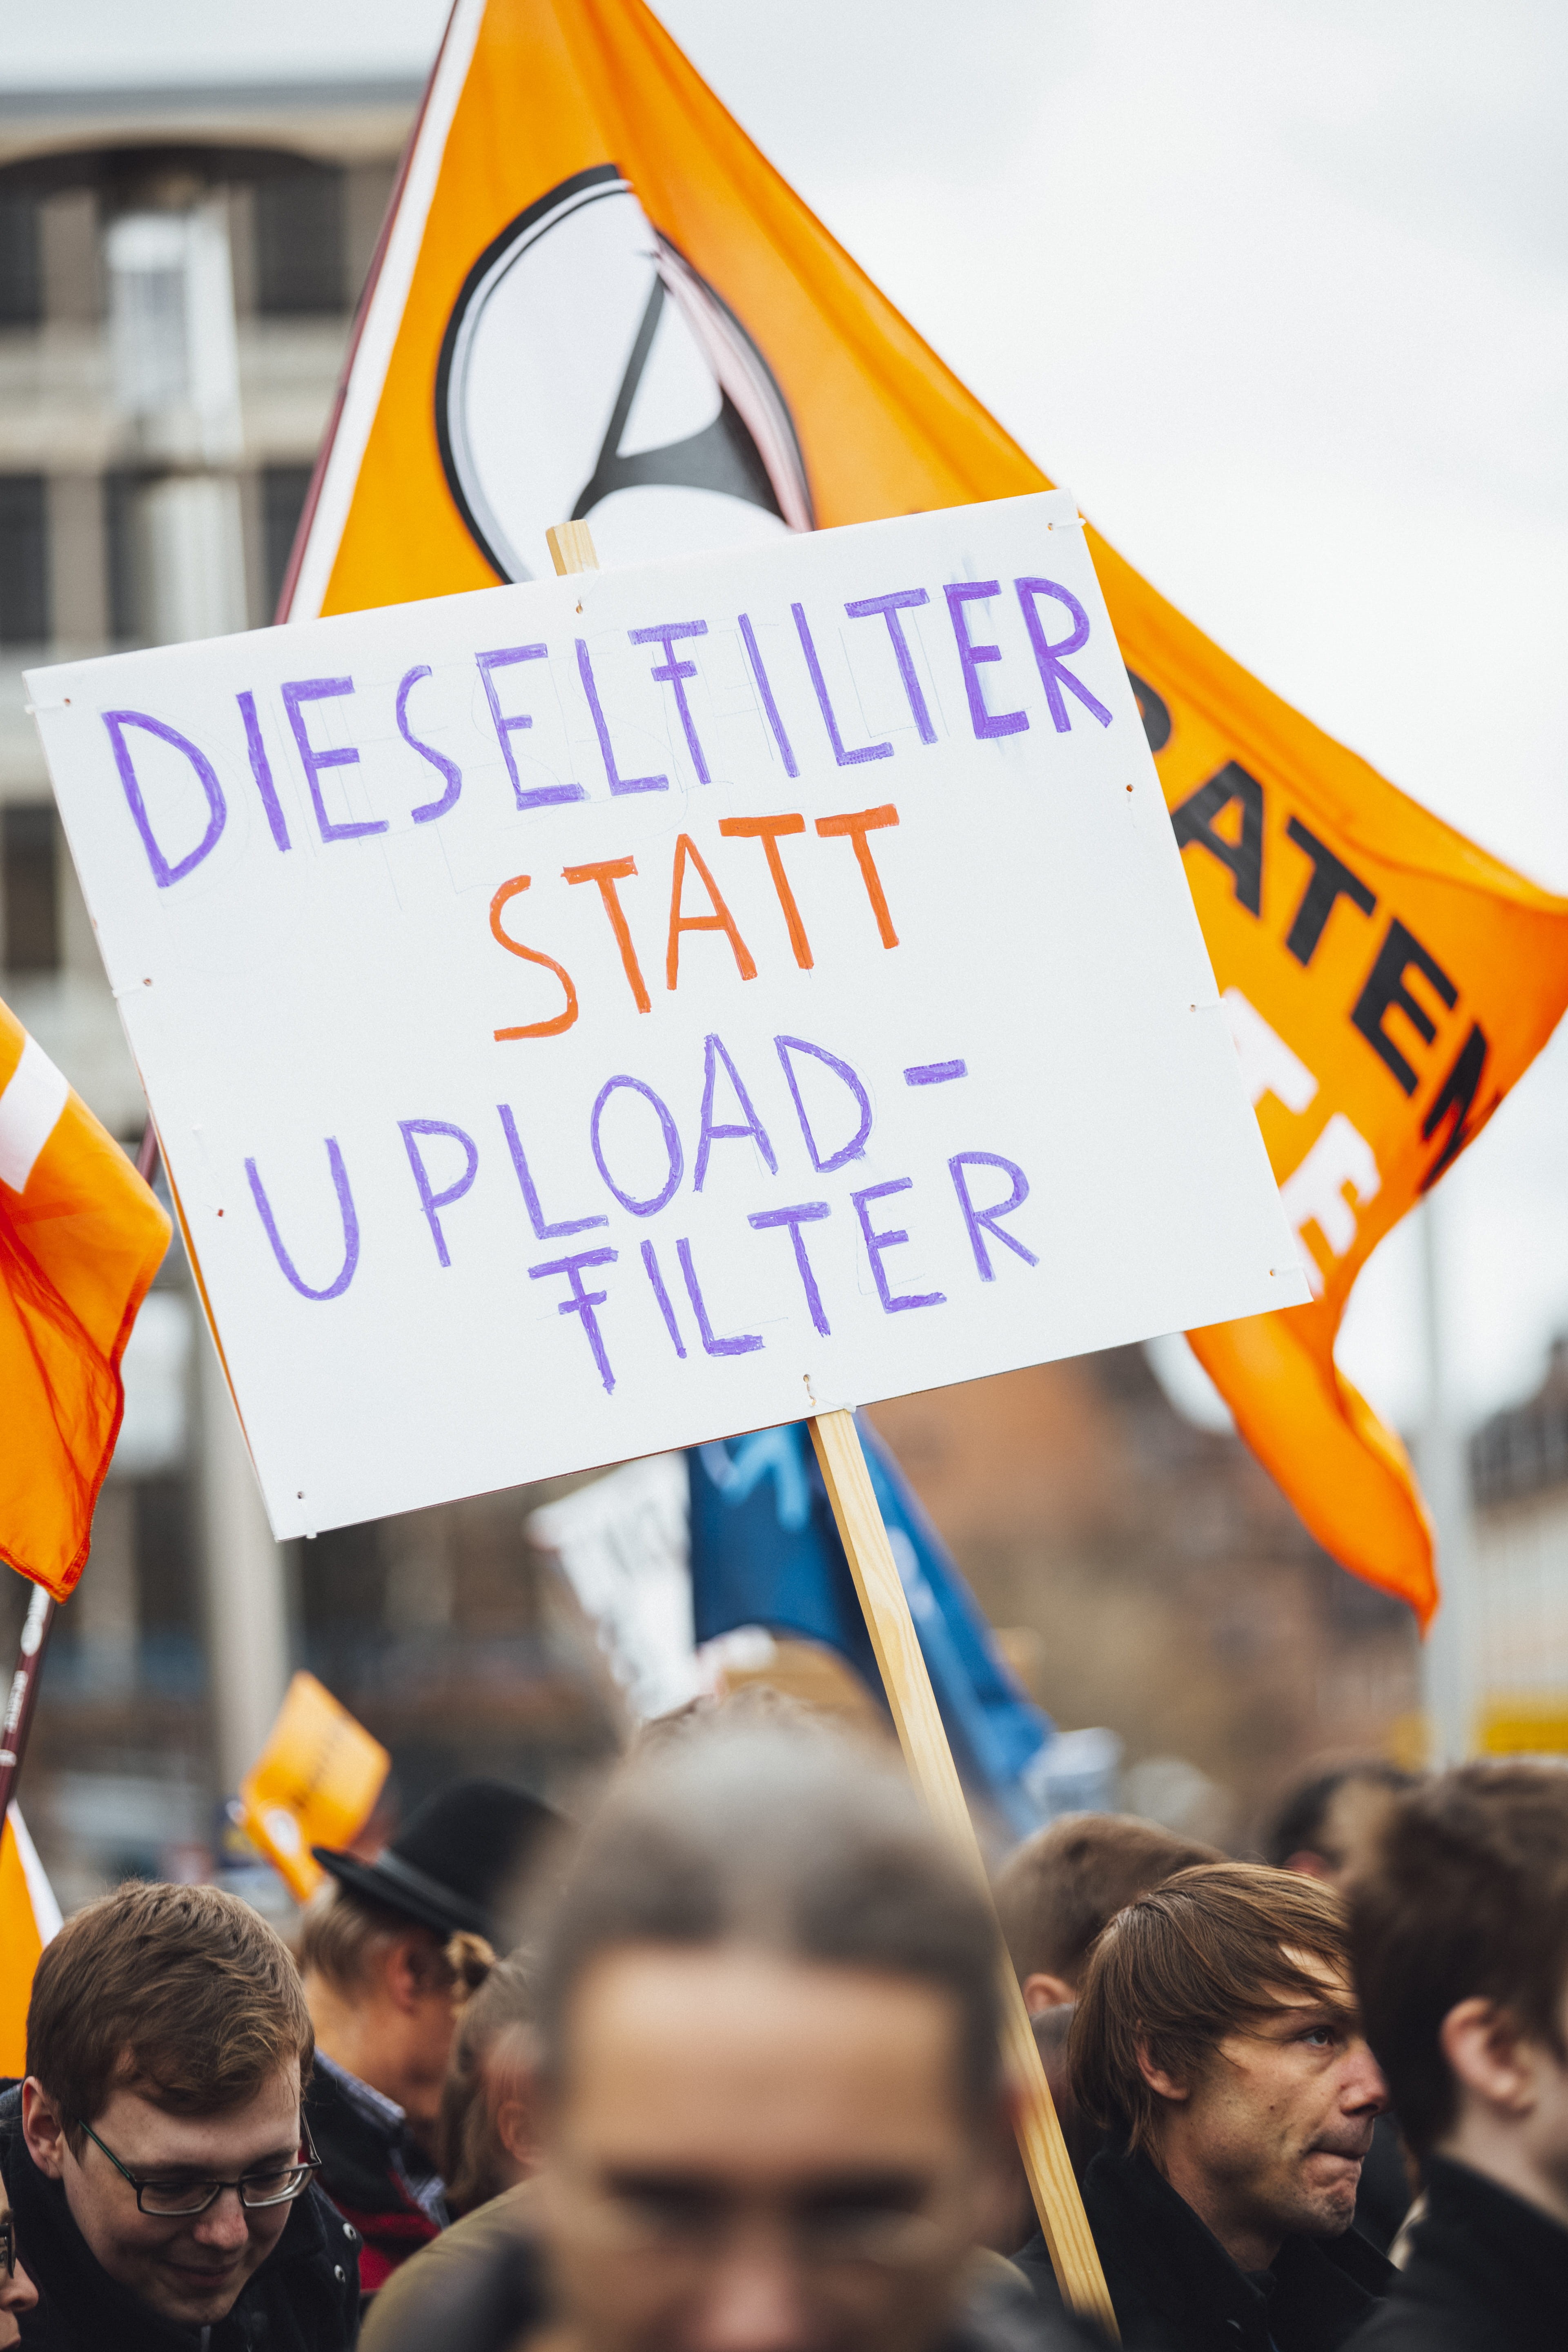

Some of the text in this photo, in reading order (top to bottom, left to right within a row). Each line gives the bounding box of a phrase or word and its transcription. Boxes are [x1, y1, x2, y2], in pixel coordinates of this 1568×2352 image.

[102, 577, 1113, 888] DIESELFILTER
[490, 805, 899, 1041] STATT
[245, 1035, 966, 1301] UPLOAD-
[528, 1152, 1036, 1394] FILTER
